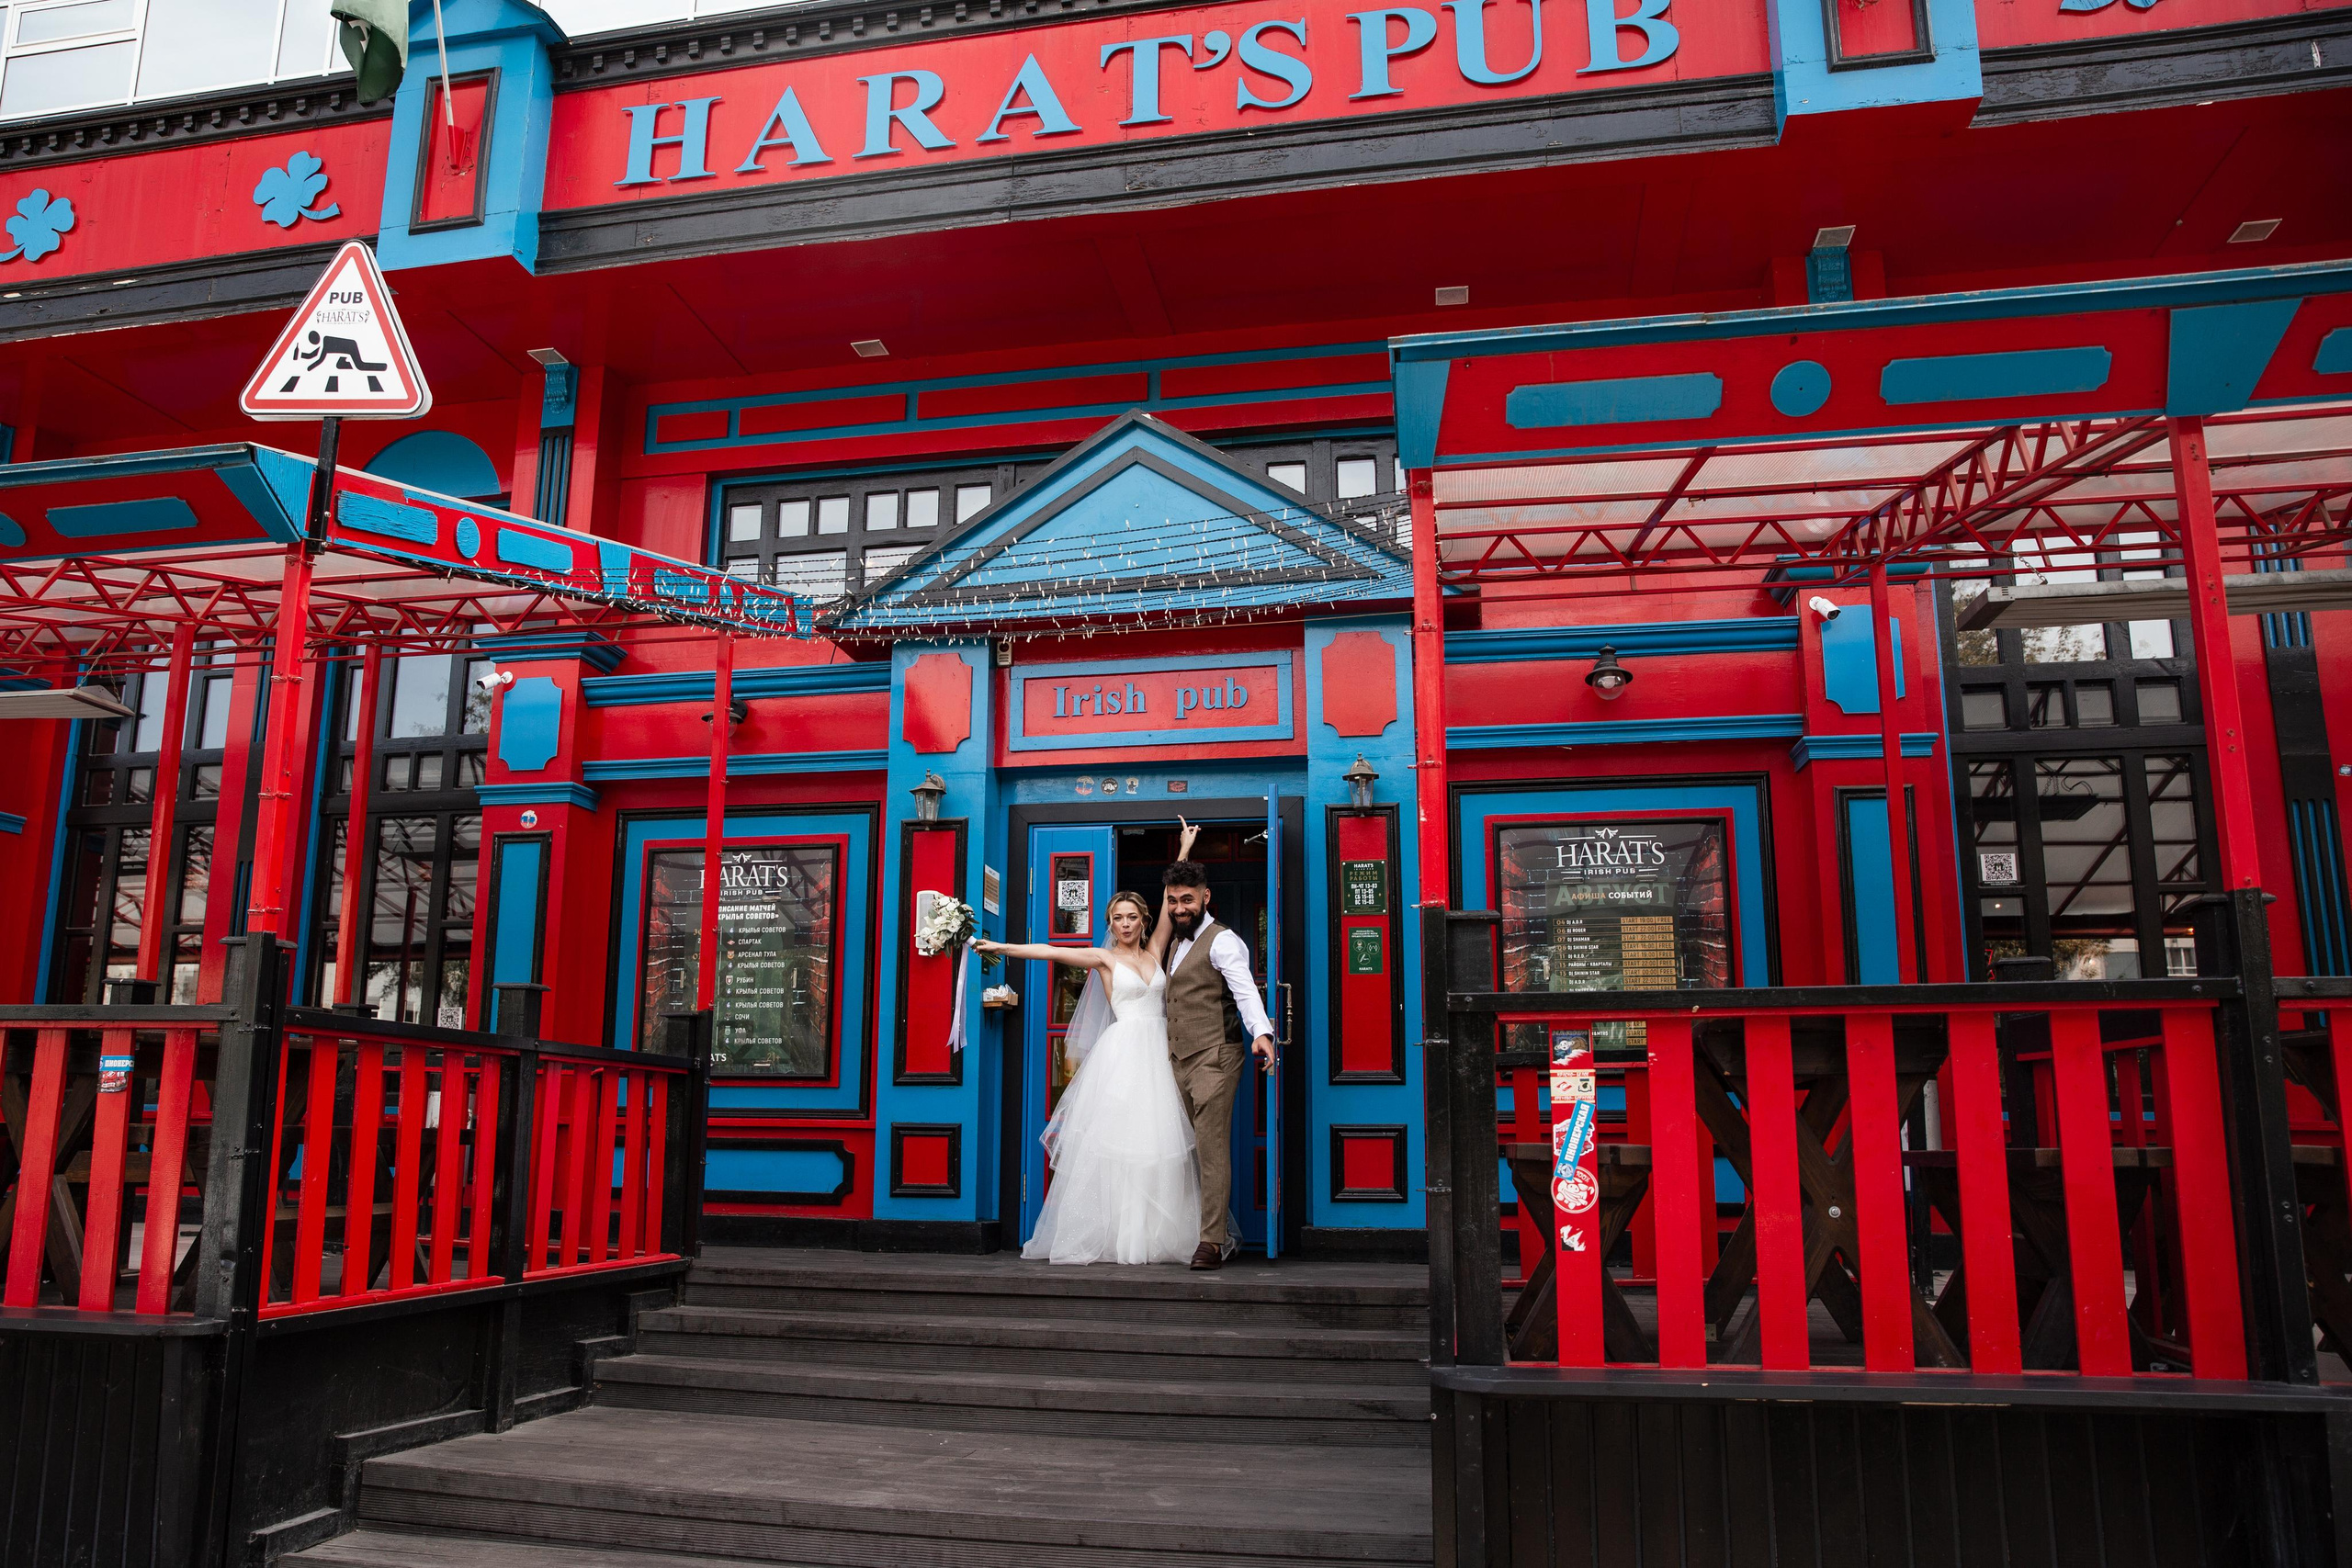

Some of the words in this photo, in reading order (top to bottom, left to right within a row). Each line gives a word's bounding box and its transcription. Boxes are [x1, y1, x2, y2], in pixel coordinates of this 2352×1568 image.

[614, 17, 1313, 186] HARAT'S
[1345, 0, 1680, 100] PUB
[329, 292, 363, 304] PUB
[1053, 682, 1147, 717] Irish
[1174, 677, 1249, 719] pub
[1555, 840, 1665, 868] HARAT'S
[1554, 883, 1669, 906] АВГУСТ
[1571, 892, 1606, 900] АФИША
[1608, 889, 1653, 899] СОБЫТИЙ
[749, 903, 775, 911] МАТЧЕЙ
[710, 1053, 727, 1062] AT'S
[766, 1052, 780, 1061] 21+
[105, 1059, 134, 1067] ПИОНЕРС
[1565, 1103, 1589, 1162] ПИОНЕРСКАЯ
[1576, 1170, 1590, 1182] 100%
